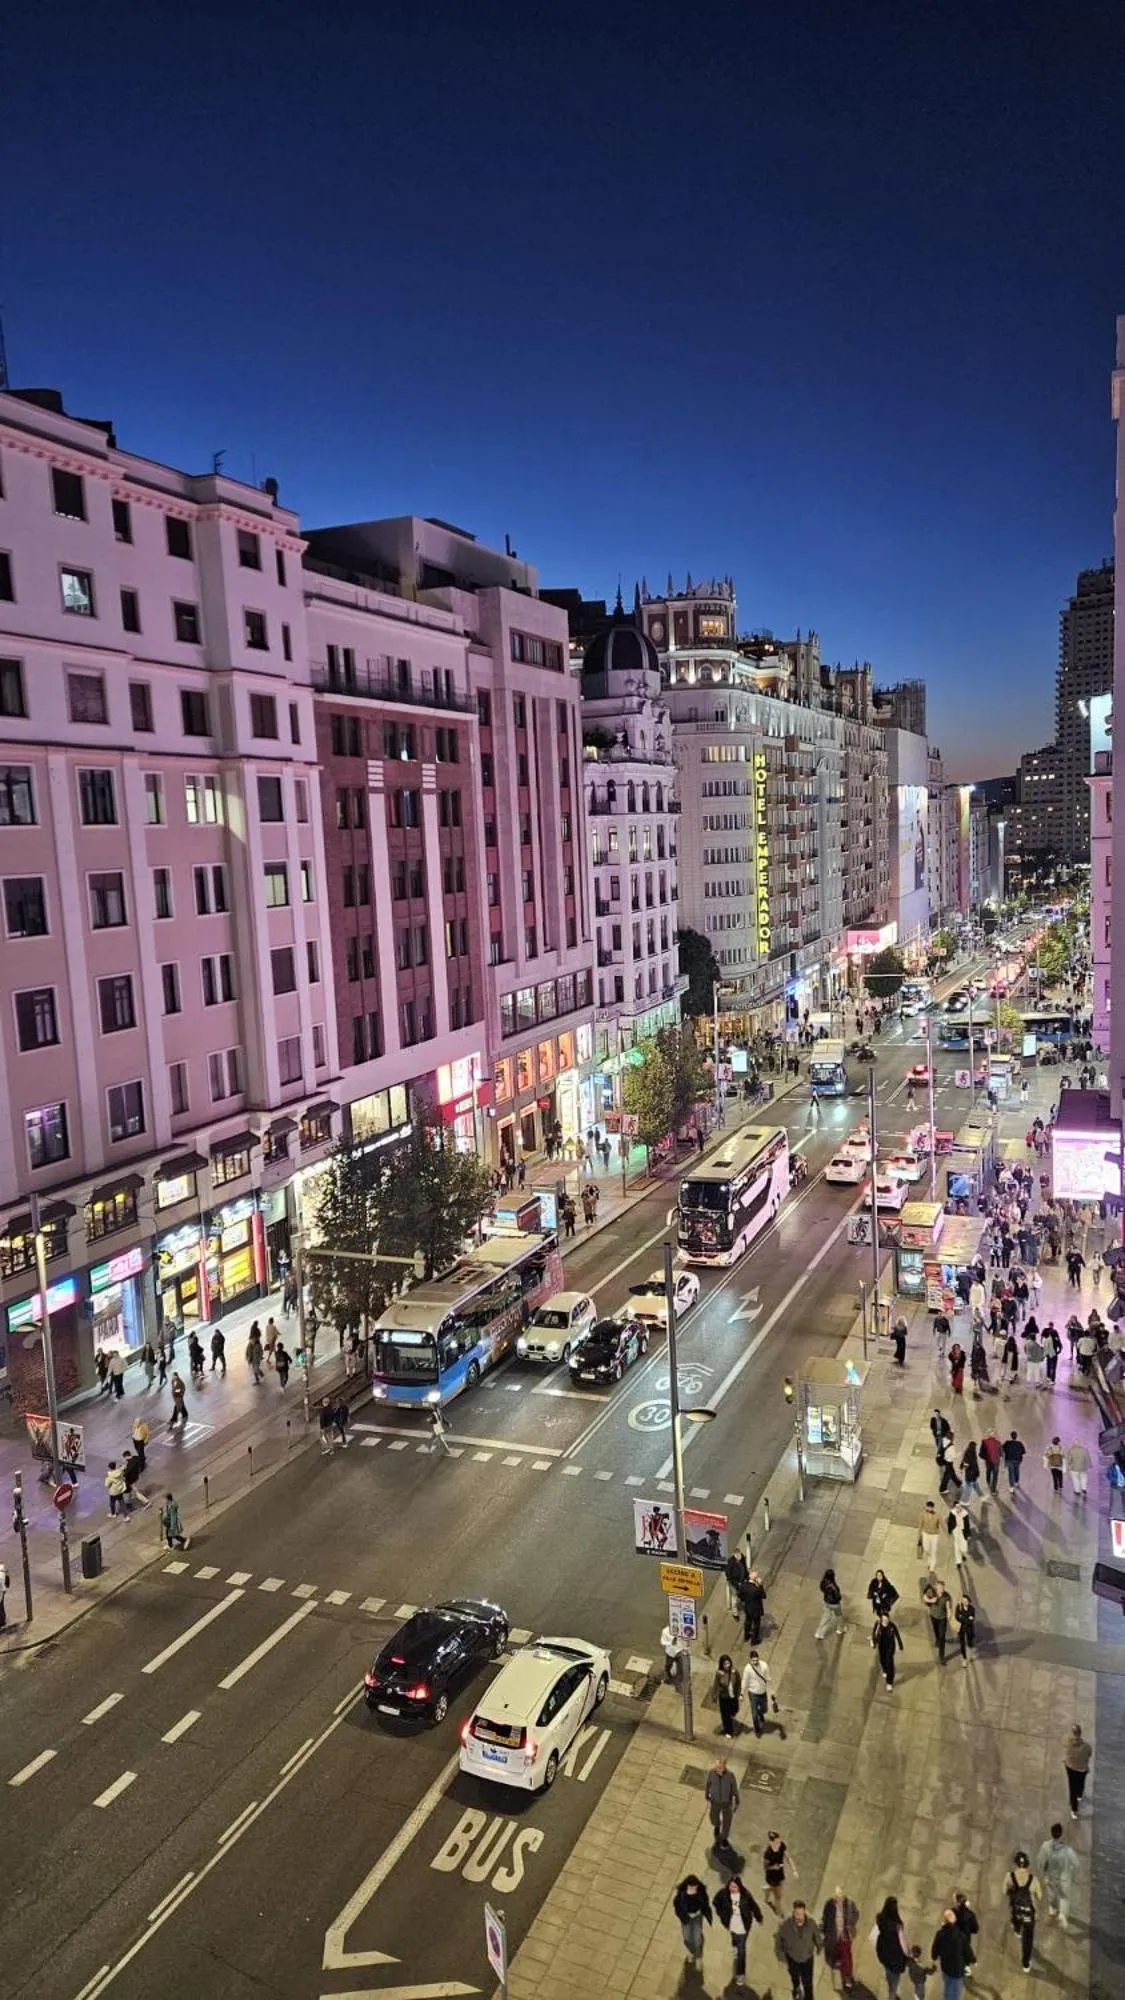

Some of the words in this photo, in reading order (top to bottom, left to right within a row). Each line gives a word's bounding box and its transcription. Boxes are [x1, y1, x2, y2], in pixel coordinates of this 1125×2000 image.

[755, 755, 767, 824] HOTEL
[757, 832, 771, 953] EMPERADOR
[640, 1407, 671, 1424] 30
[430, 1807, 545, 1893] BUS
